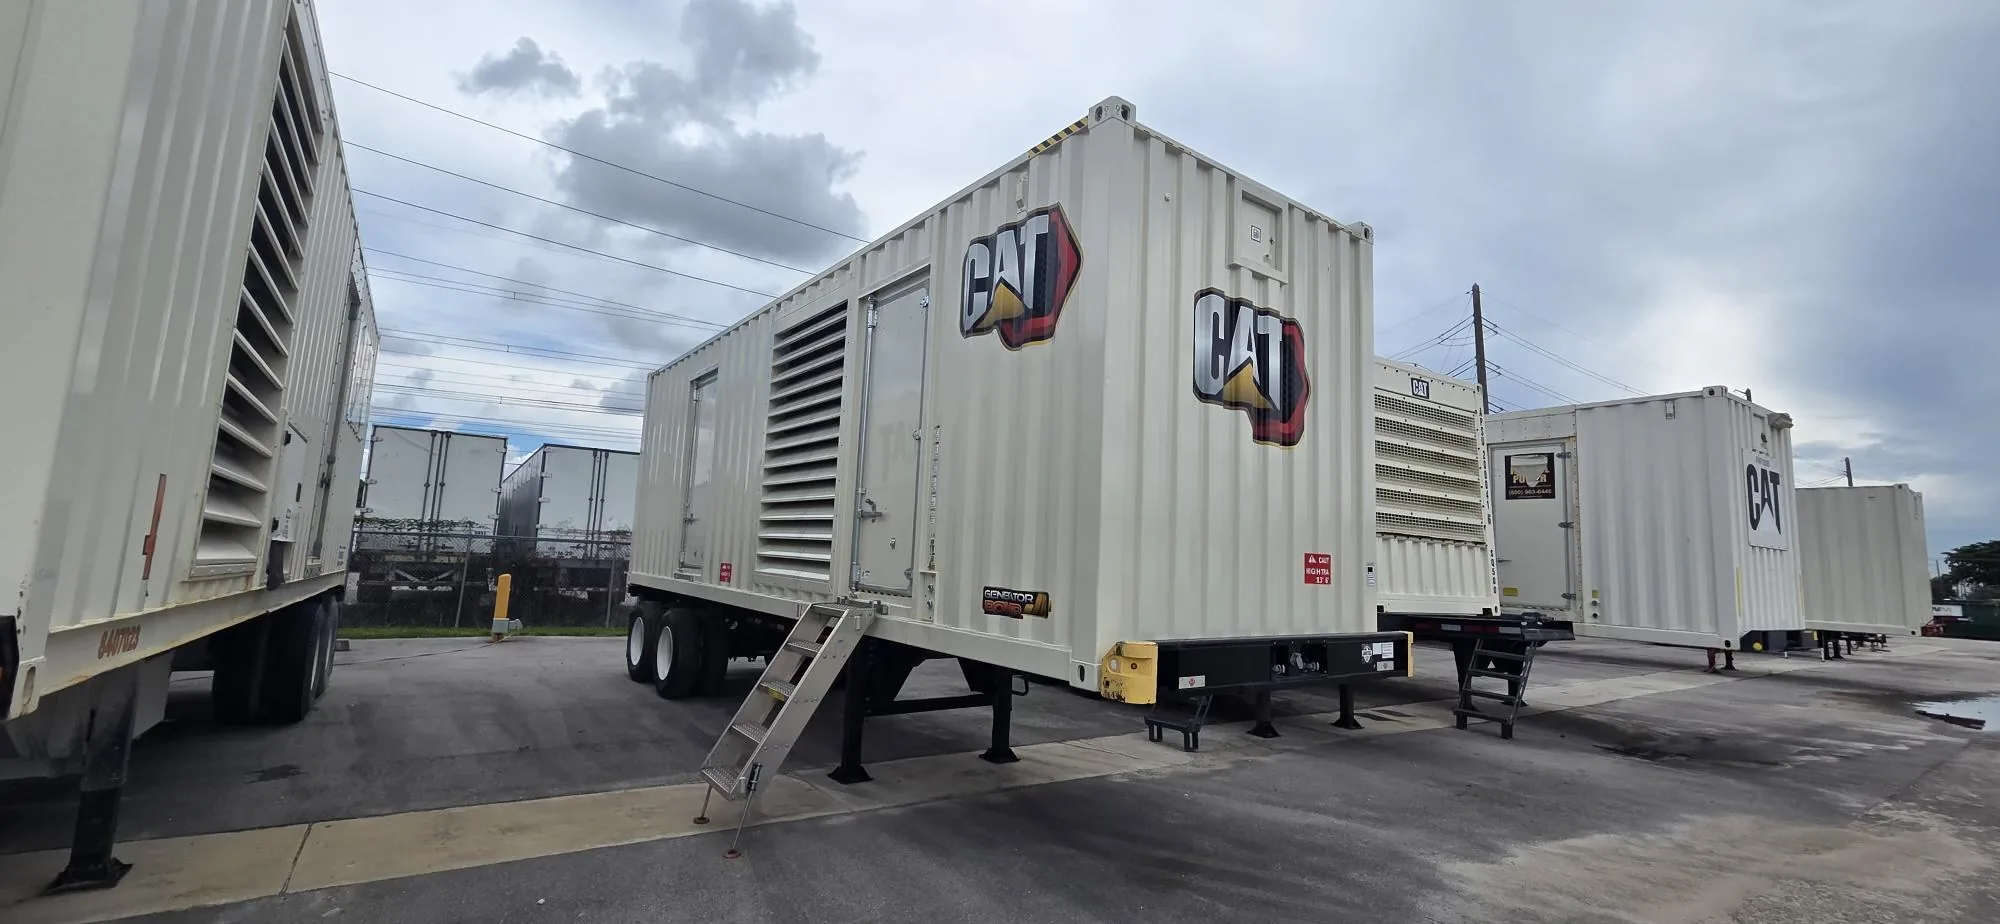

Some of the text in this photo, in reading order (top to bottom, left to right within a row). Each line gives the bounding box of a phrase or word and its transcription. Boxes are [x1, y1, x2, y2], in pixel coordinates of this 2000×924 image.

[963, 213, 1049, 331] CAT
[1194, 293, 1283, 412] CAT
[1412, 380, 1428, 396] CAT
[1746, 463, 1782, 535] CAT
[984, 589, 1034, 603] GENEATOR
[984, 600, 1022, 615] POR
